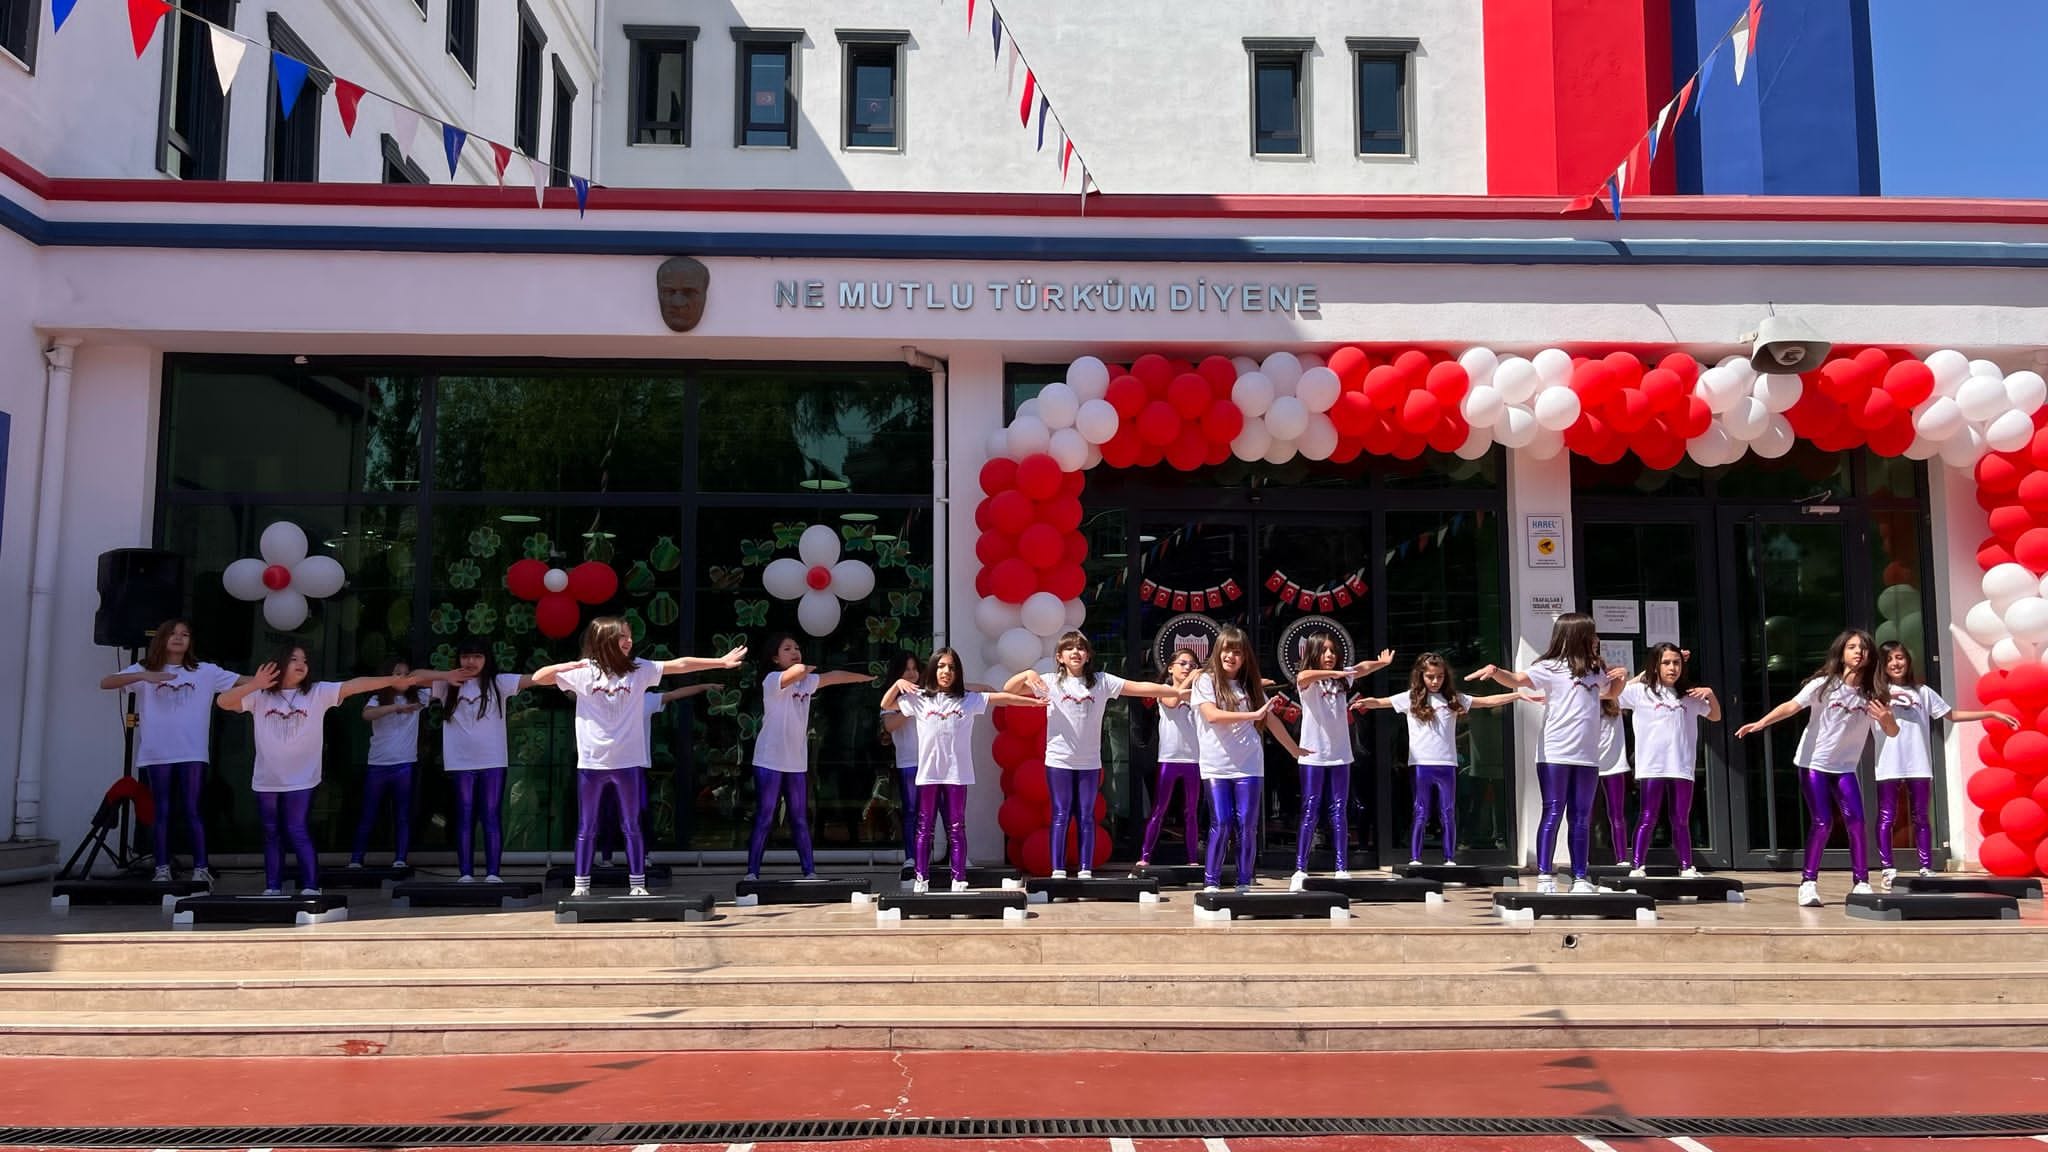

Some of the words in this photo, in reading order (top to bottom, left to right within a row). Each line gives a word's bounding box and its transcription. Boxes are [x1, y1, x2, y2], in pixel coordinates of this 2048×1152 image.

[775, 281, 825, 308] NE
[839, 281, 973, 310] MUTLU
[1169, 280, 1319, 312] DİYENE
